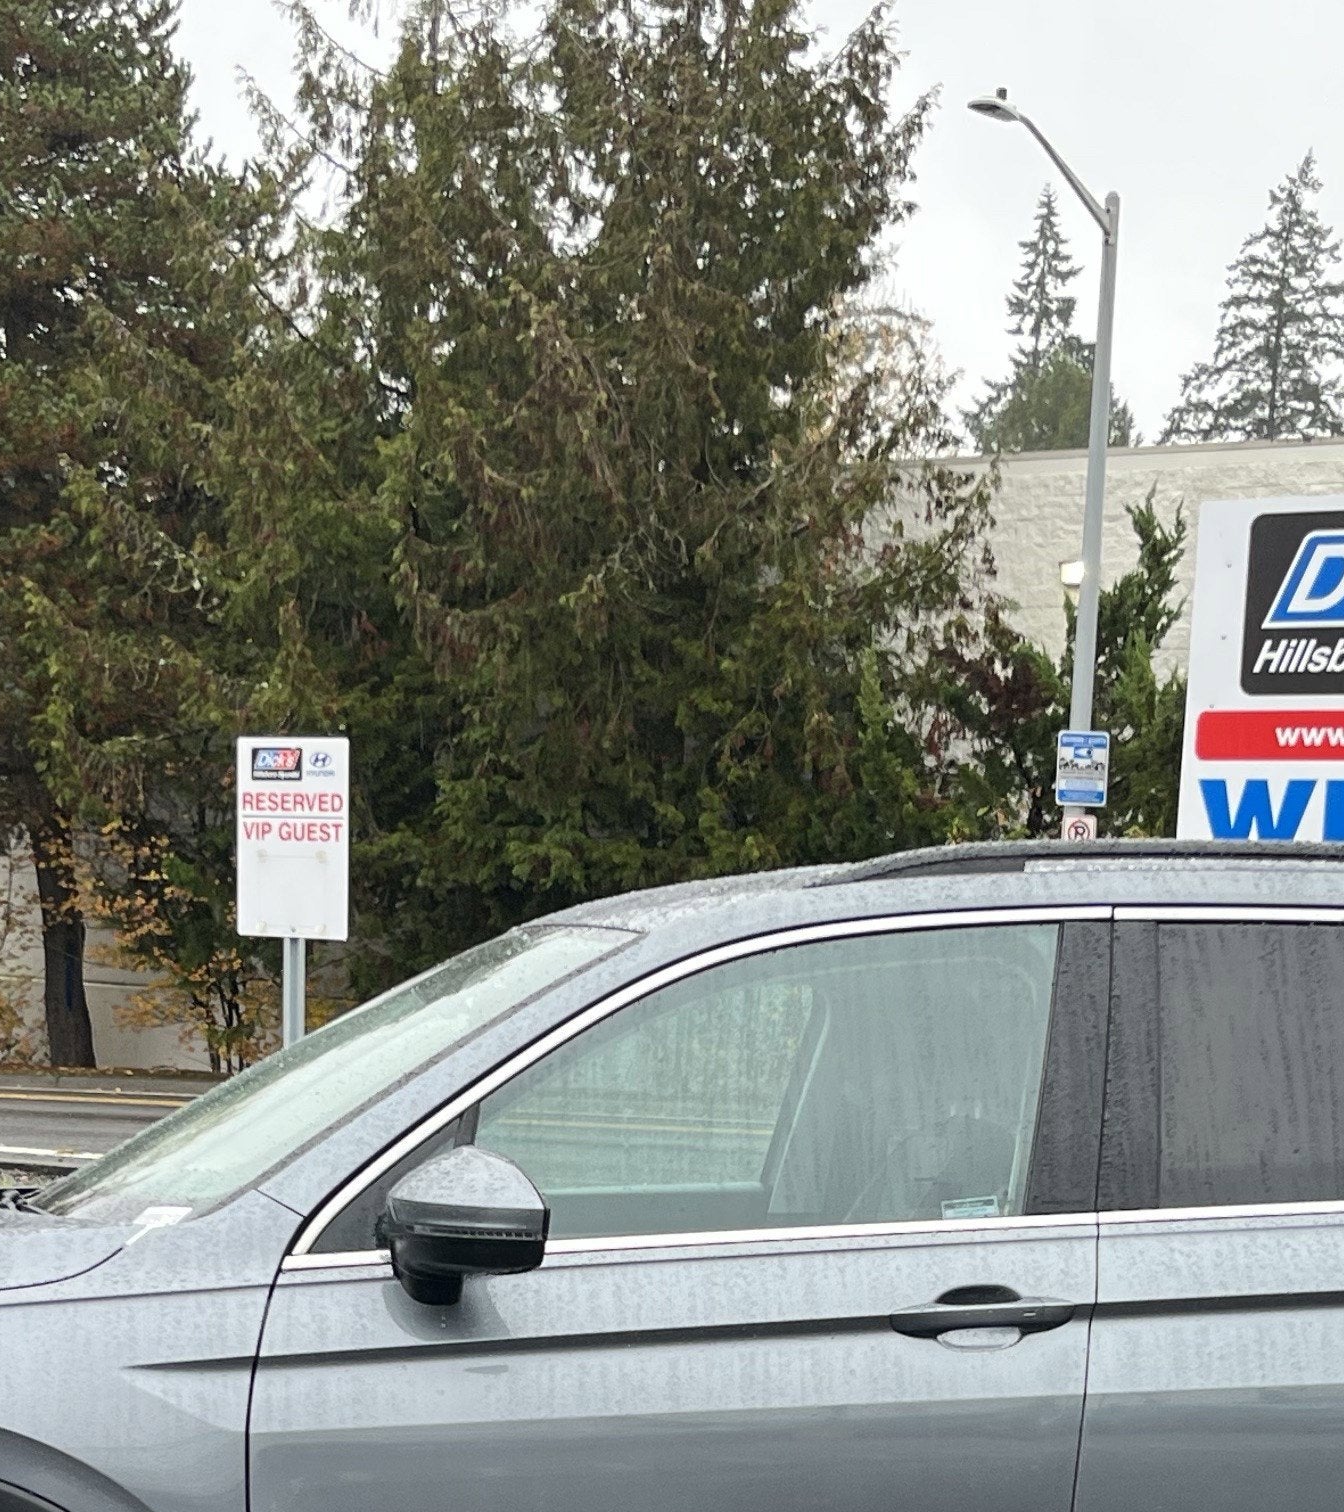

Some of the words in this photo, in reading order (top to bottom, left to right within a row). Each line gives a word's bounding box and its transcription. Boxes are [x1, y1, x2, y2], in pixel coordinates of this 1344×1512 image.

[242, 791, 344, 812] RESERVED
[243, 822, 273, 840] VIP
[278, 822, 344, 842] GUEST
